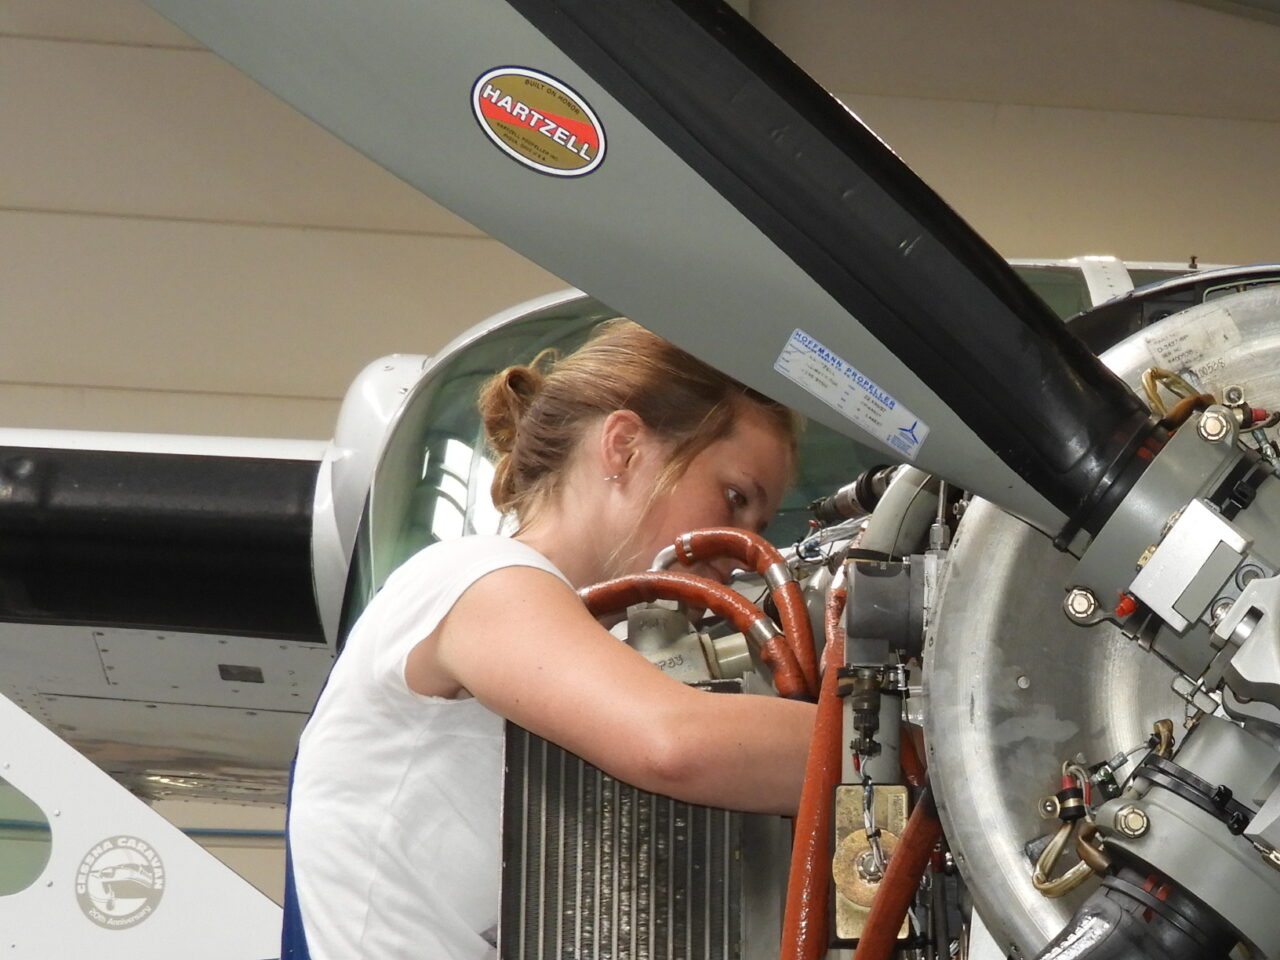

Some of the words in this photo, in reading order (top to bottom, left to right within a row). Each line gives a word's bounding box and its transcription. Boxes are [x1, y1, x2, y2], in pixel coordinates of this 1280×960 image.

[482, 84, 591, 161] HARTZELL
[524, 79, 545, 91] BUILT
[546, 88, 557, 98] ON
[557, 94, 580, 115] HONOR
[795, 331, 843, 368] HOFFMANN
[845, 367, 897, 408] PROPELLER
[77, 840, 113, 894] CESSNA
[117, 838, 162, 889] CARAVAN
